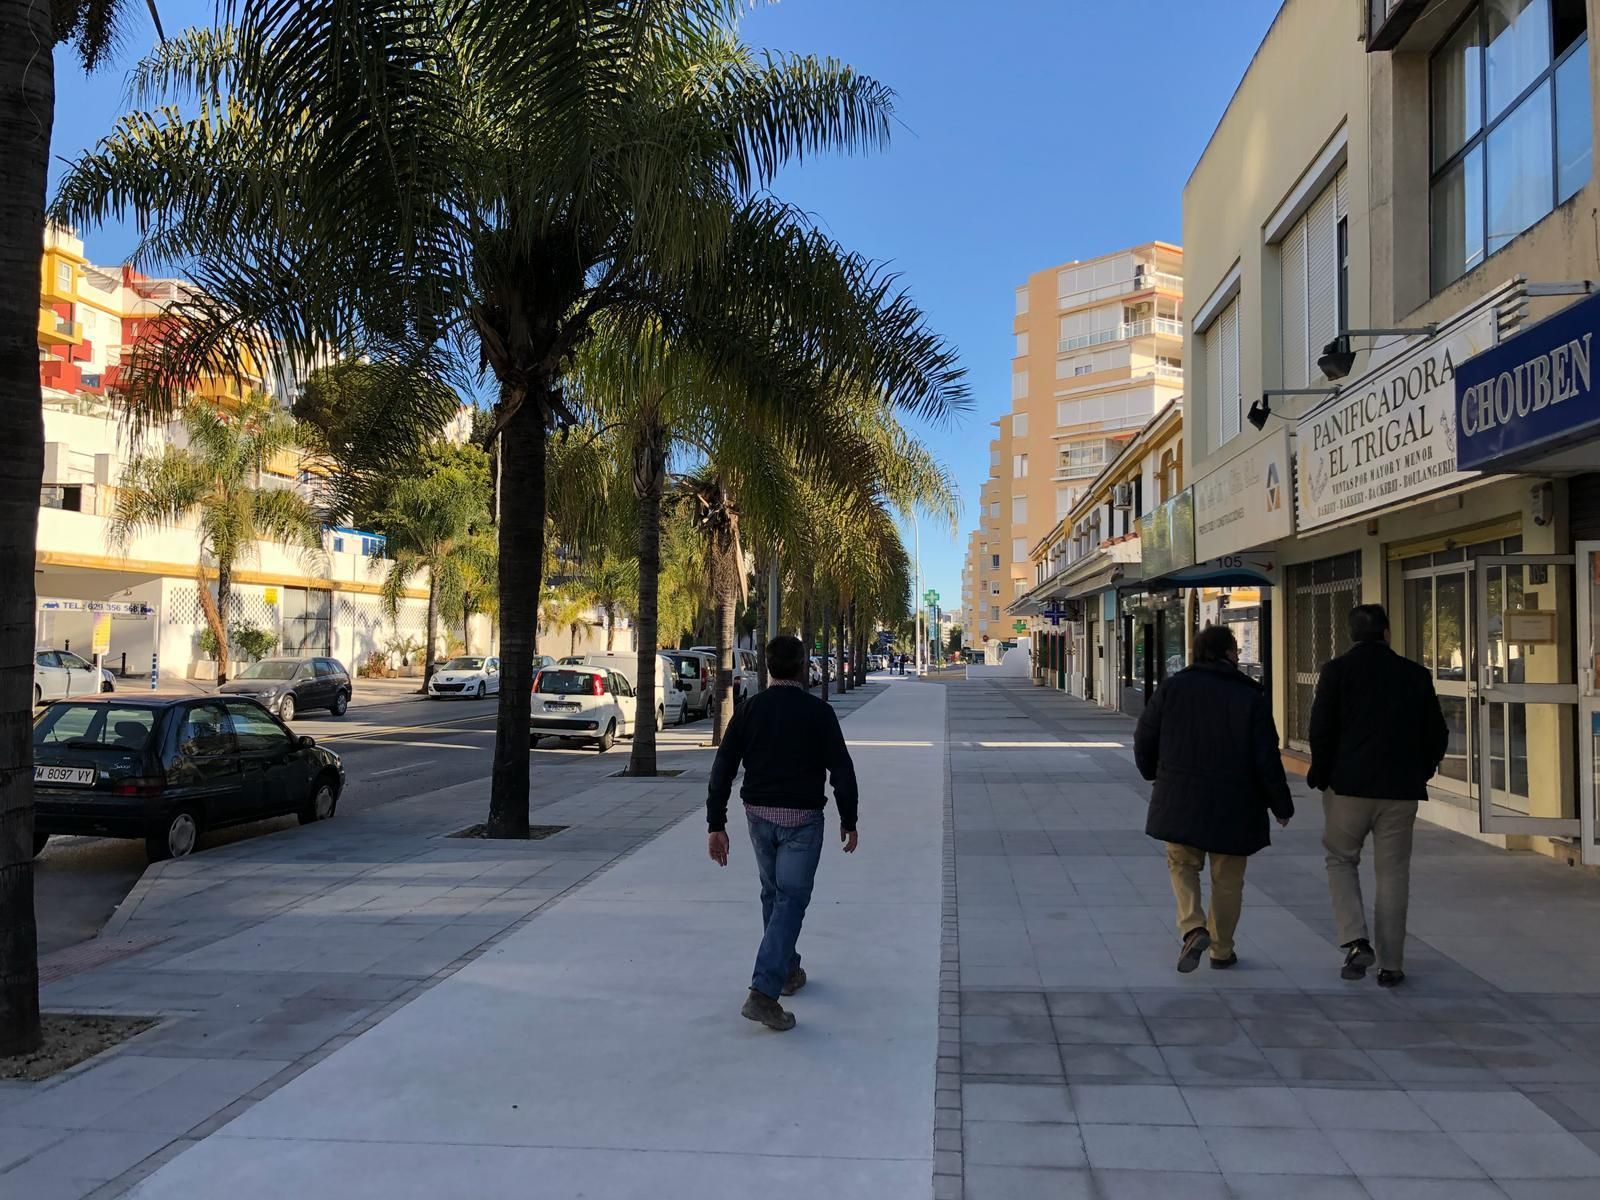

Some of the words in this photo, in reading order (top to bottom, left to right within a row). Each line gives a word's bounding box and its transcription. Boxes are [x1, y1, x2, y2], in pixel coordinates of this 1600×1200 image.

[1313, 347, 1455, 451] PANIFICADORA
[1461, 332, 1593, 437] CHOUBEN
[1329, 446, 1349, 478] EL
[1352, 404, 1434, 468] TRIGAL
[1332, 478, 1354, 495] VENTAS
[1370, 460, 1395, 481] MAYOR
[1404, 445, 1433, 468] MENOR
[1216, 556, 1243, 569] 105
[47, 768, 73, 780] 8097
[78, 770, 92, 782] VY
